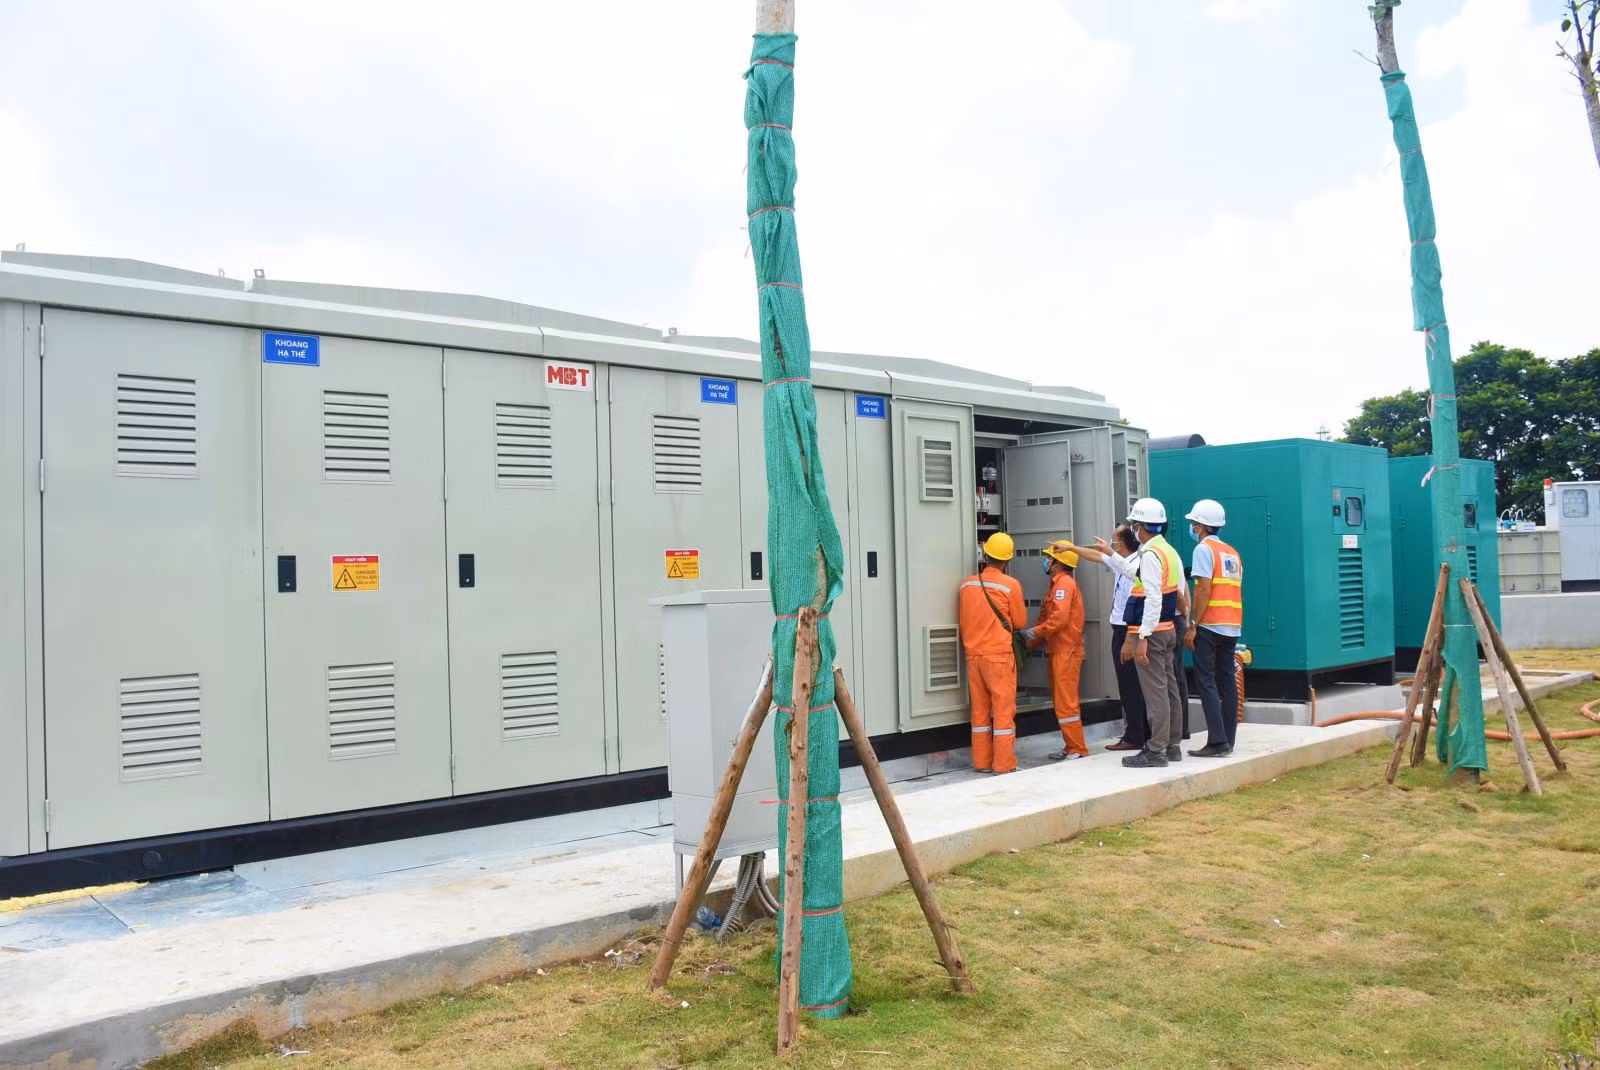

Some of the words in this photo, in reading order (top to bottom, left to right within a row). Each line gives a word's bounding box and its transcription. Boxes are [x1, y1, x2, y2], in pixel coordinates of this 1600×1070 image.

[275, 339, 309, 349] KHOANG
[278, 350, 290, 359] HẠ
[291, 349, 307, 359] THẾ
[547, 365, 590, 387] MBT
